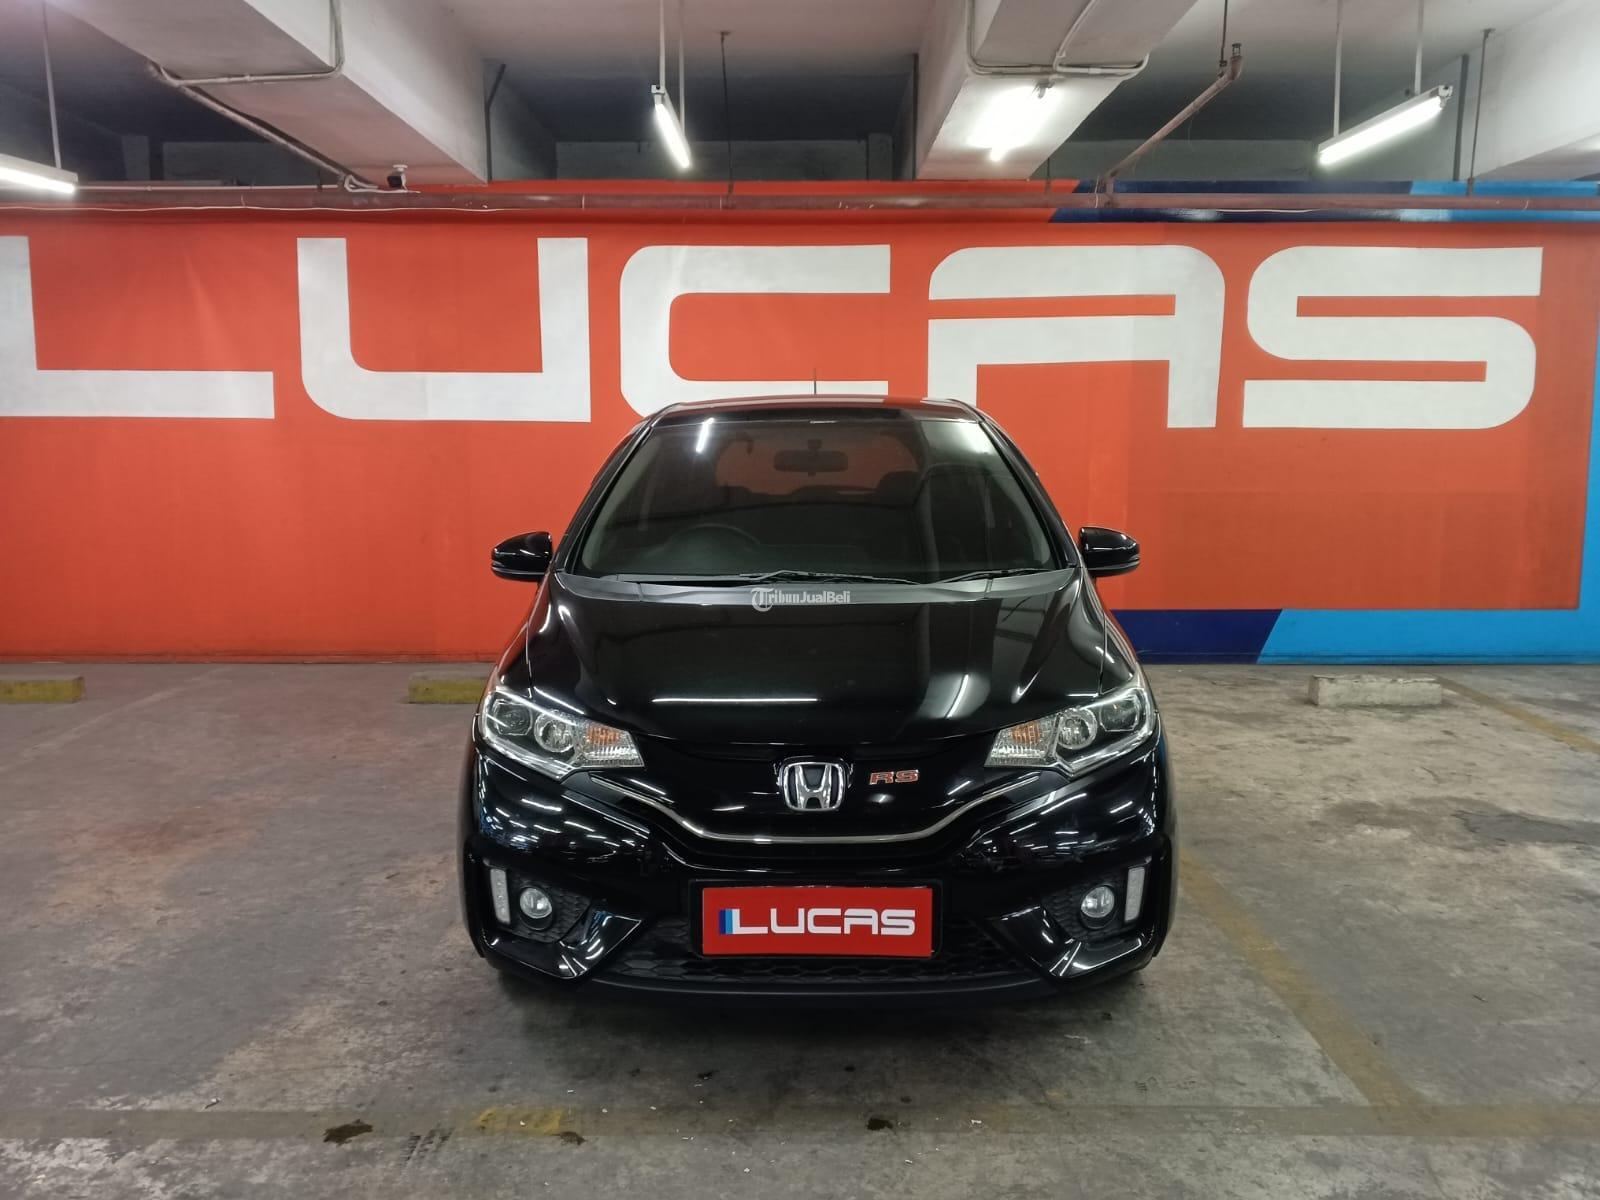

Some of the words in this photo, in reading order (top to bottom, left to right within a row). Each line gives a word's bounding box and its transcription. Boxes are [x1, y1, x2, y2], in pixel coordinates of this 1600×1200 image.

[0, 235, 1543, 430] LUCAS
[869, 769, 919, 785] RS
[731, 908, 916, 935] LUCAS
